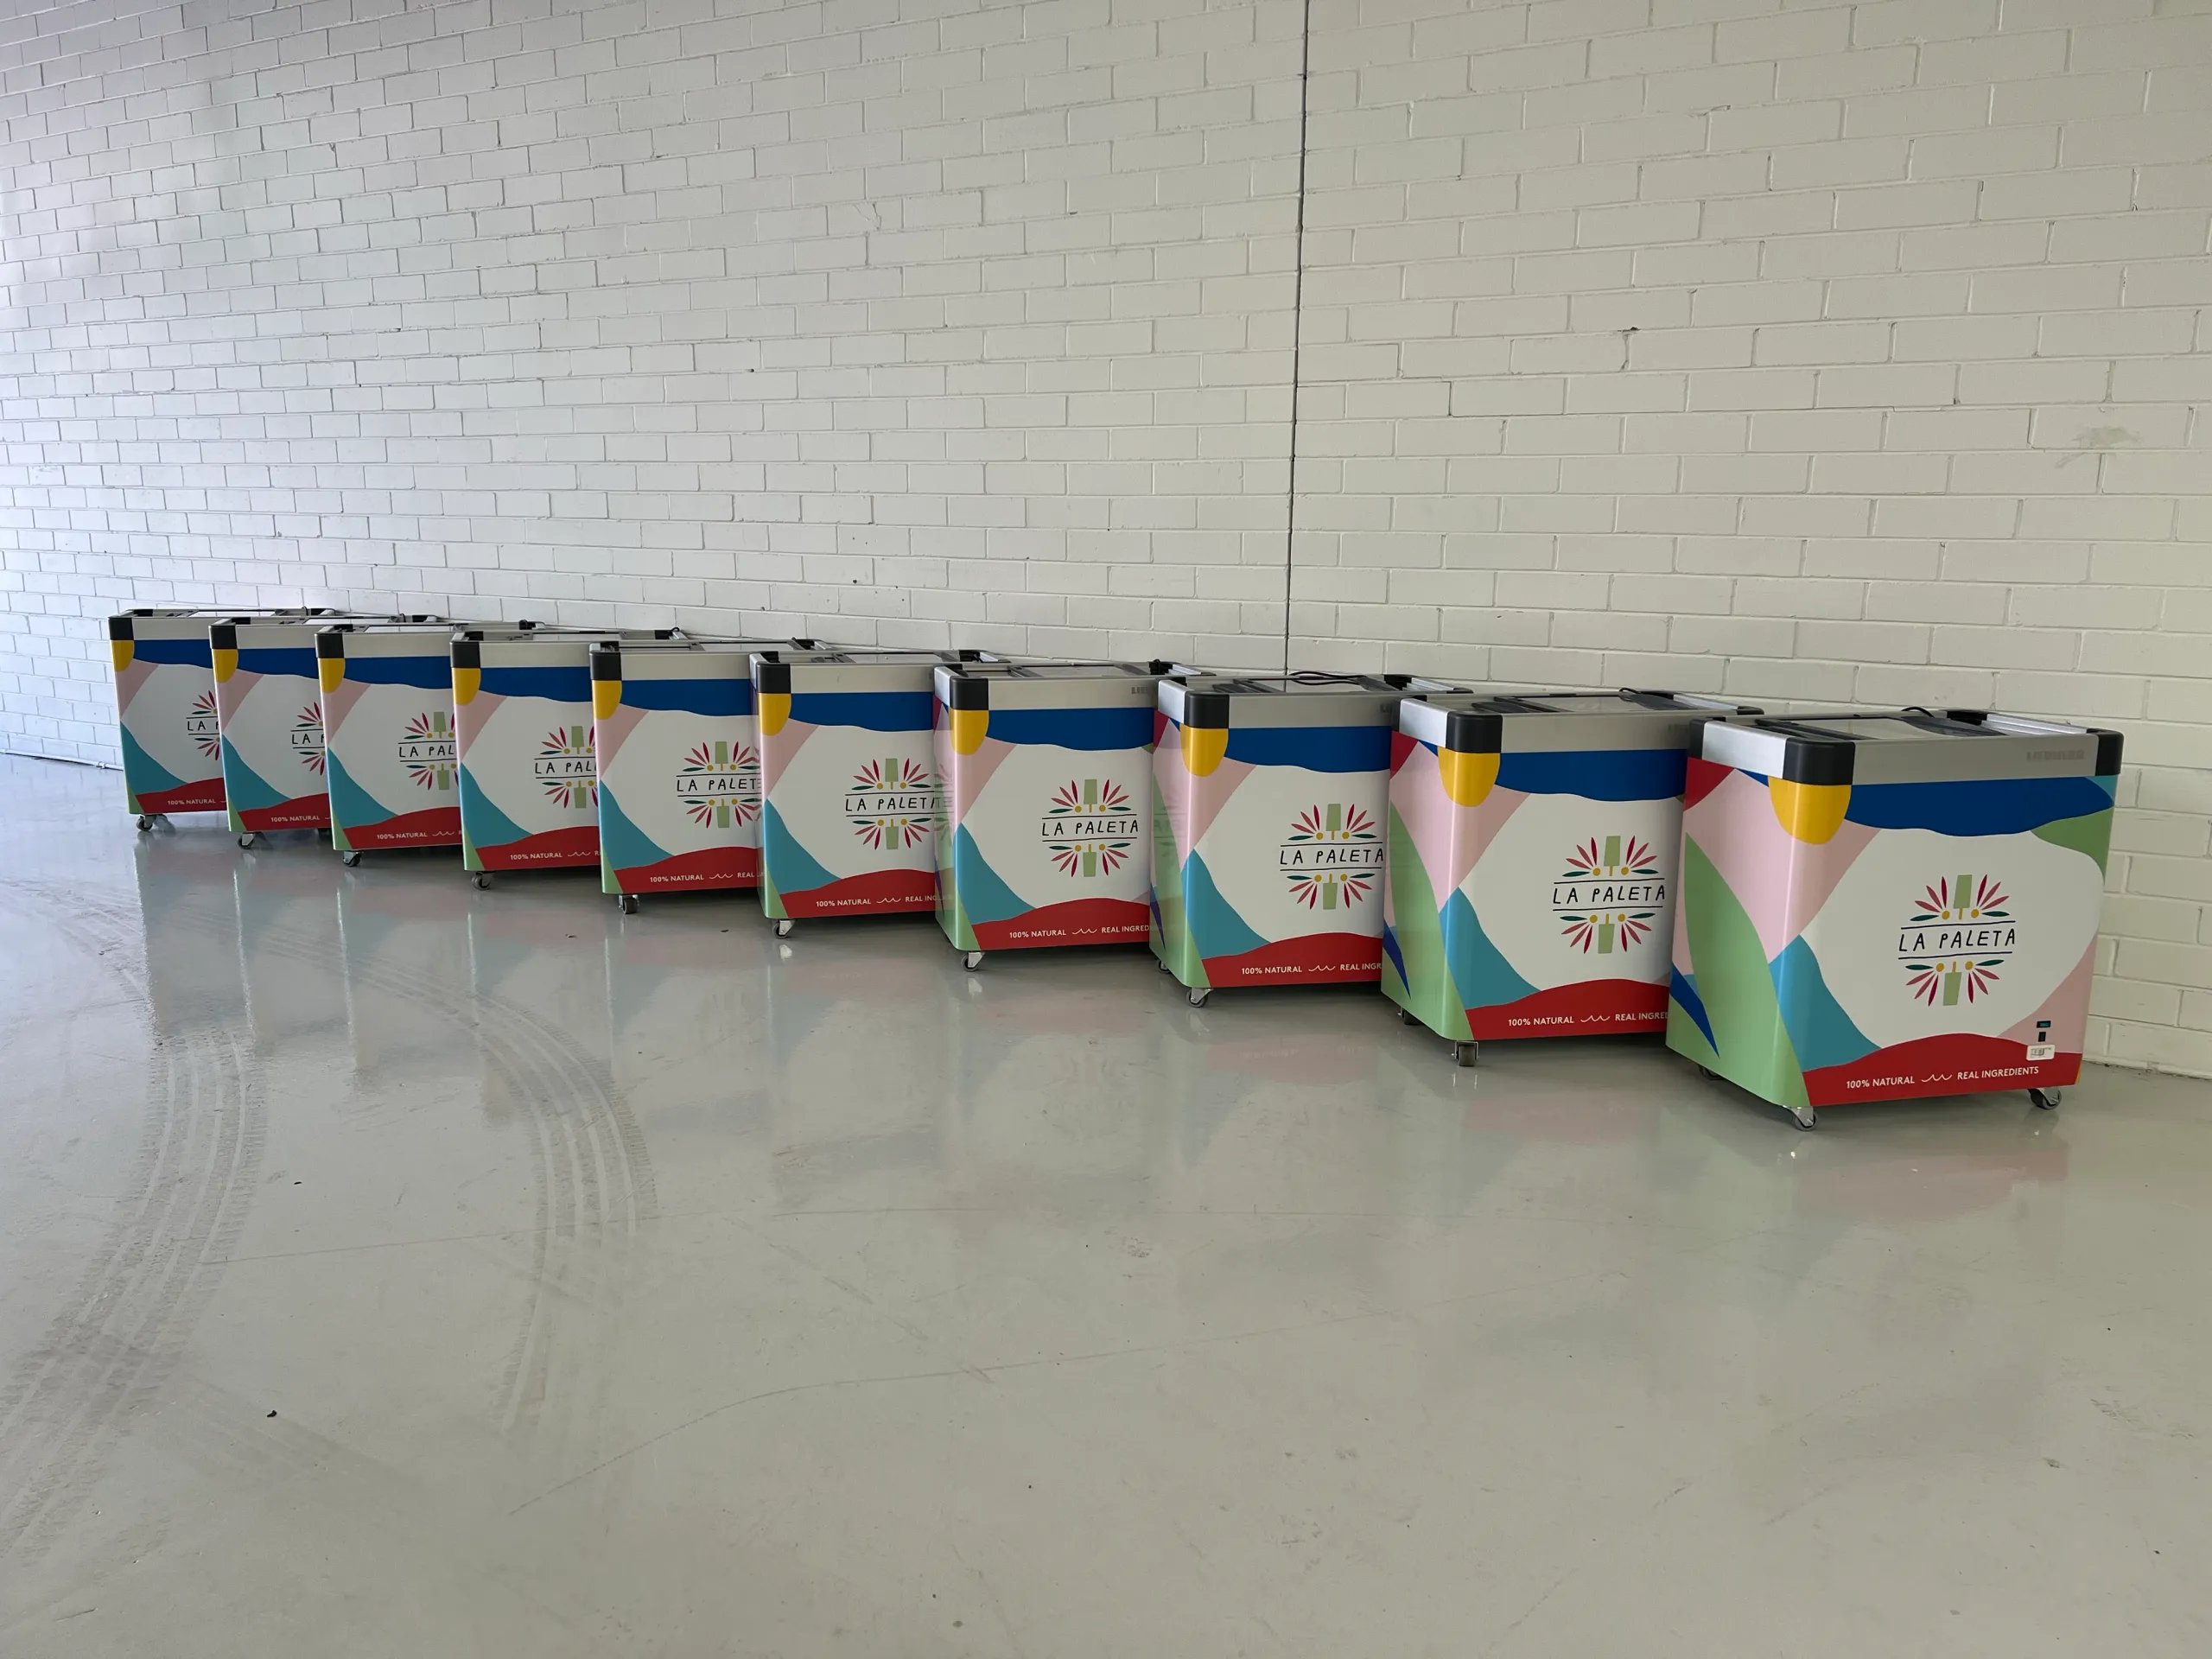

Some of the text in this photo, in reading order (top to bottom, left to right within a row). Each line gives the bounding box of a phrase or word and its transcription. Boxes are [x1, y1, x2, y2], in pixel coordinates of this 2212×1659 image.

[187, 721, 207, 731] LA
[291, 734, 311, 745] LA
[398, 747, 419, 758] LA
[535, 760, 596, 774] LA PAL
[677, 779, 698, 792] LA
[845, 798, 867, 811] LA
[1041, 819, 1139, 836] LA PALETA
[1280, 848, 1384, 866] LA PALETA
[670, 874, 704, 882] NATURAL
[1553, 885, 1666, 905] LA PALETA
[836, 898, 872, 906] NATURAL
[1031, 929, 1067, 938] NATURAL
[1101, 925, 1121, 934] REAL
[1898, 928, 2016, 952] LA PALETA
[1264, 965, 1303, 974] NATURAL
[1508, 1018, 1531, 1027] 100%
[1533, 1015, 1574, 1026] NATURAL
[1614, 1013, 1637, 1021] REAL
[1846, 1065, 2039, 1089] 100% NATURAL REAL INGREDIENTS
